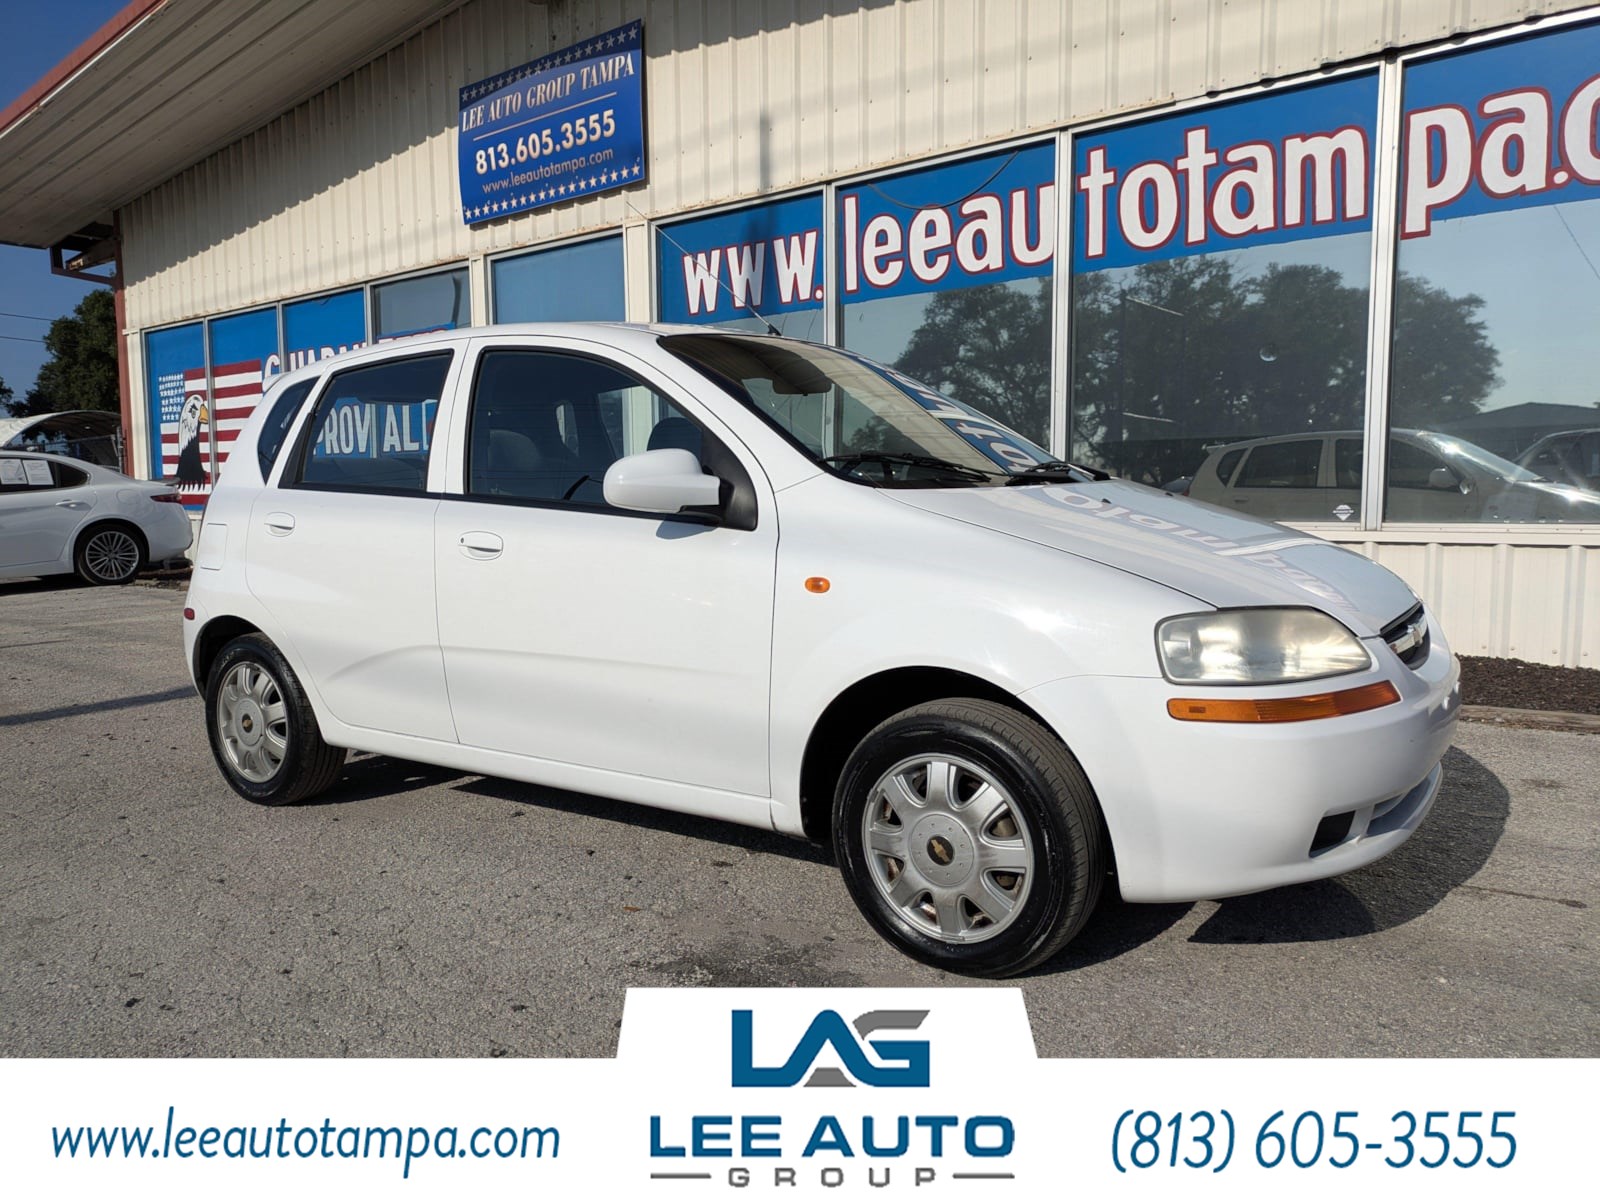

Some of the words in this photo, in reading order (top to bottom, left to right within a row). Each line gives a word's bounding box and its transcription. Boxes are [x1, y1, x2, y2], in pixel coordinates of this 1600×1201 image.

[462, 104, 485, 132] LEE
[487, 91, 522, 121] AUTO
[526, 72, 576, 109] GROUP
[580, 52, 634, 90] TAMPA
[475, 109, 616, 175] 813.605.3555
[482, 148, 614, 194] www.leeautotampa.com
